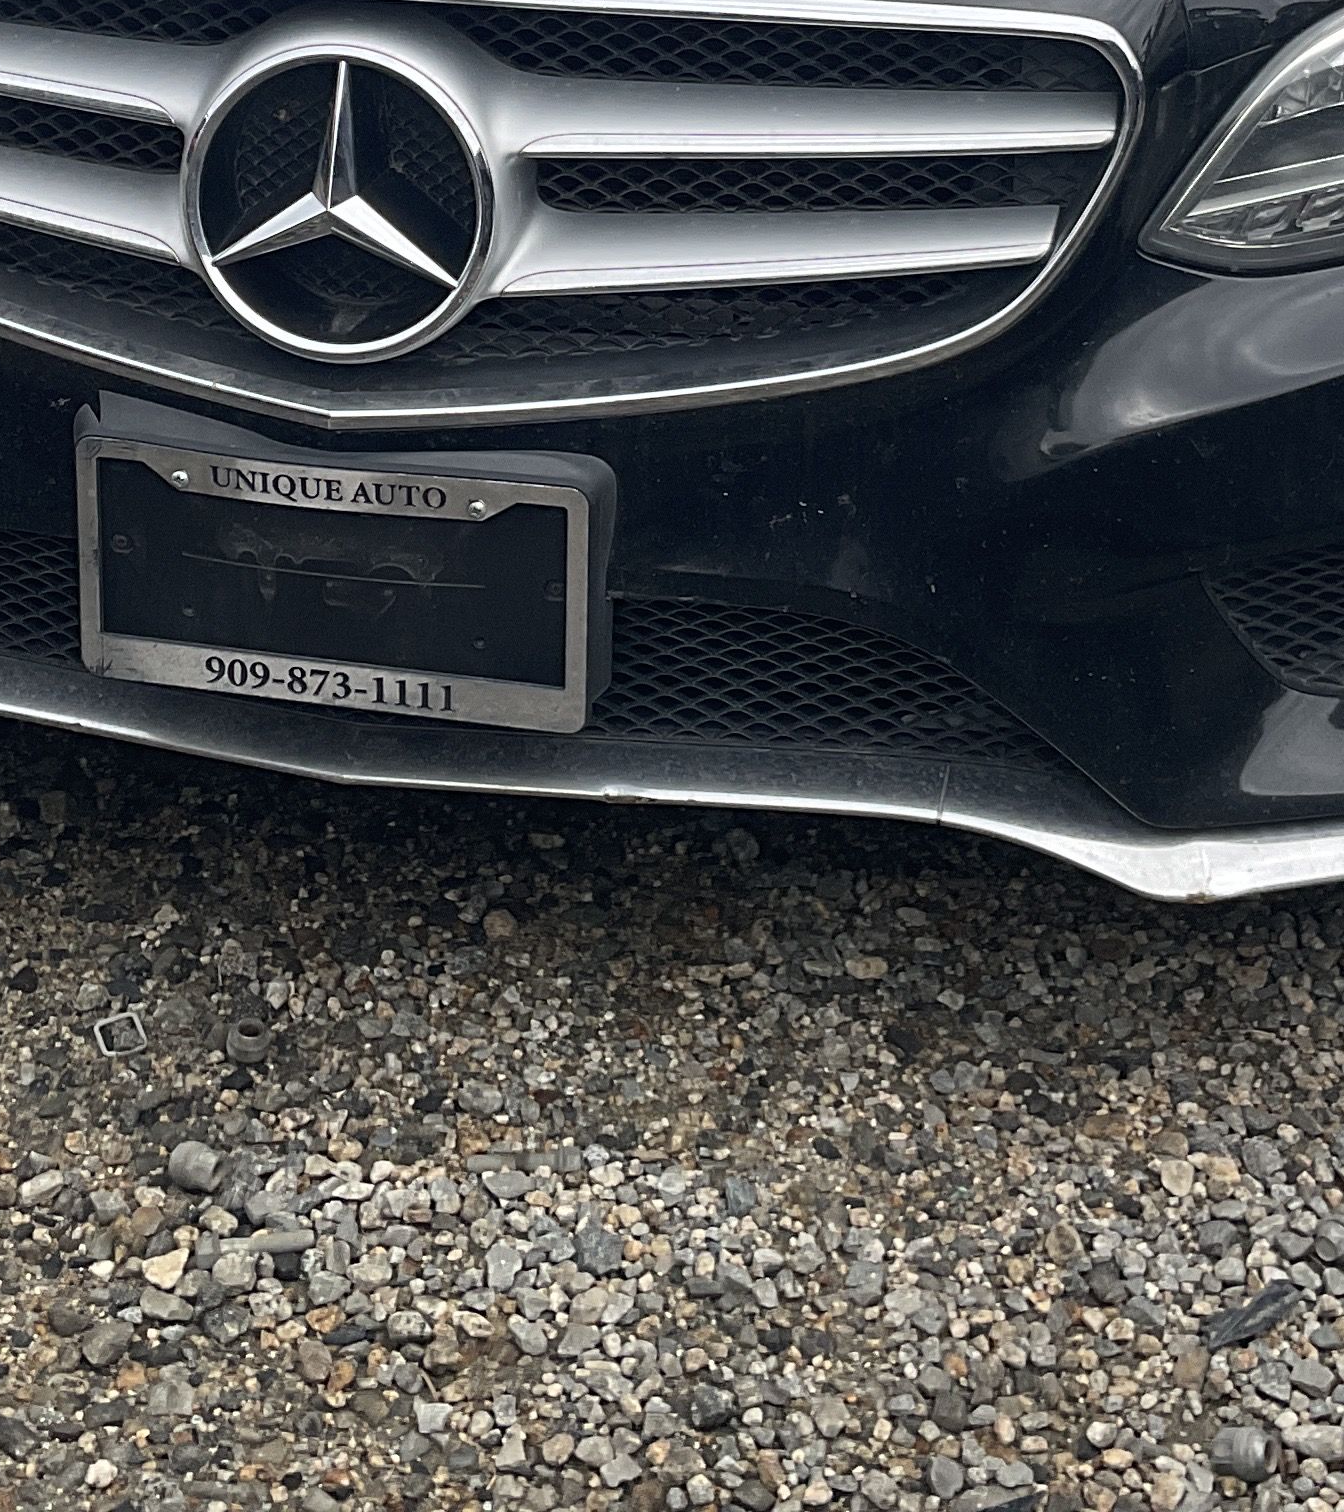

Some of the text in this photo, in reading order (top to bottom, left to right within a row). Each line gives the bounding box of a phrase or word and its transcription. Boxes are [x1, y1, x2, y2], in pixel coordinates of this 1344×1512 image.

[210, 464, 447, 510] UNIQUE AUTO
[204, 655, 455, 713] 909-873-1111
